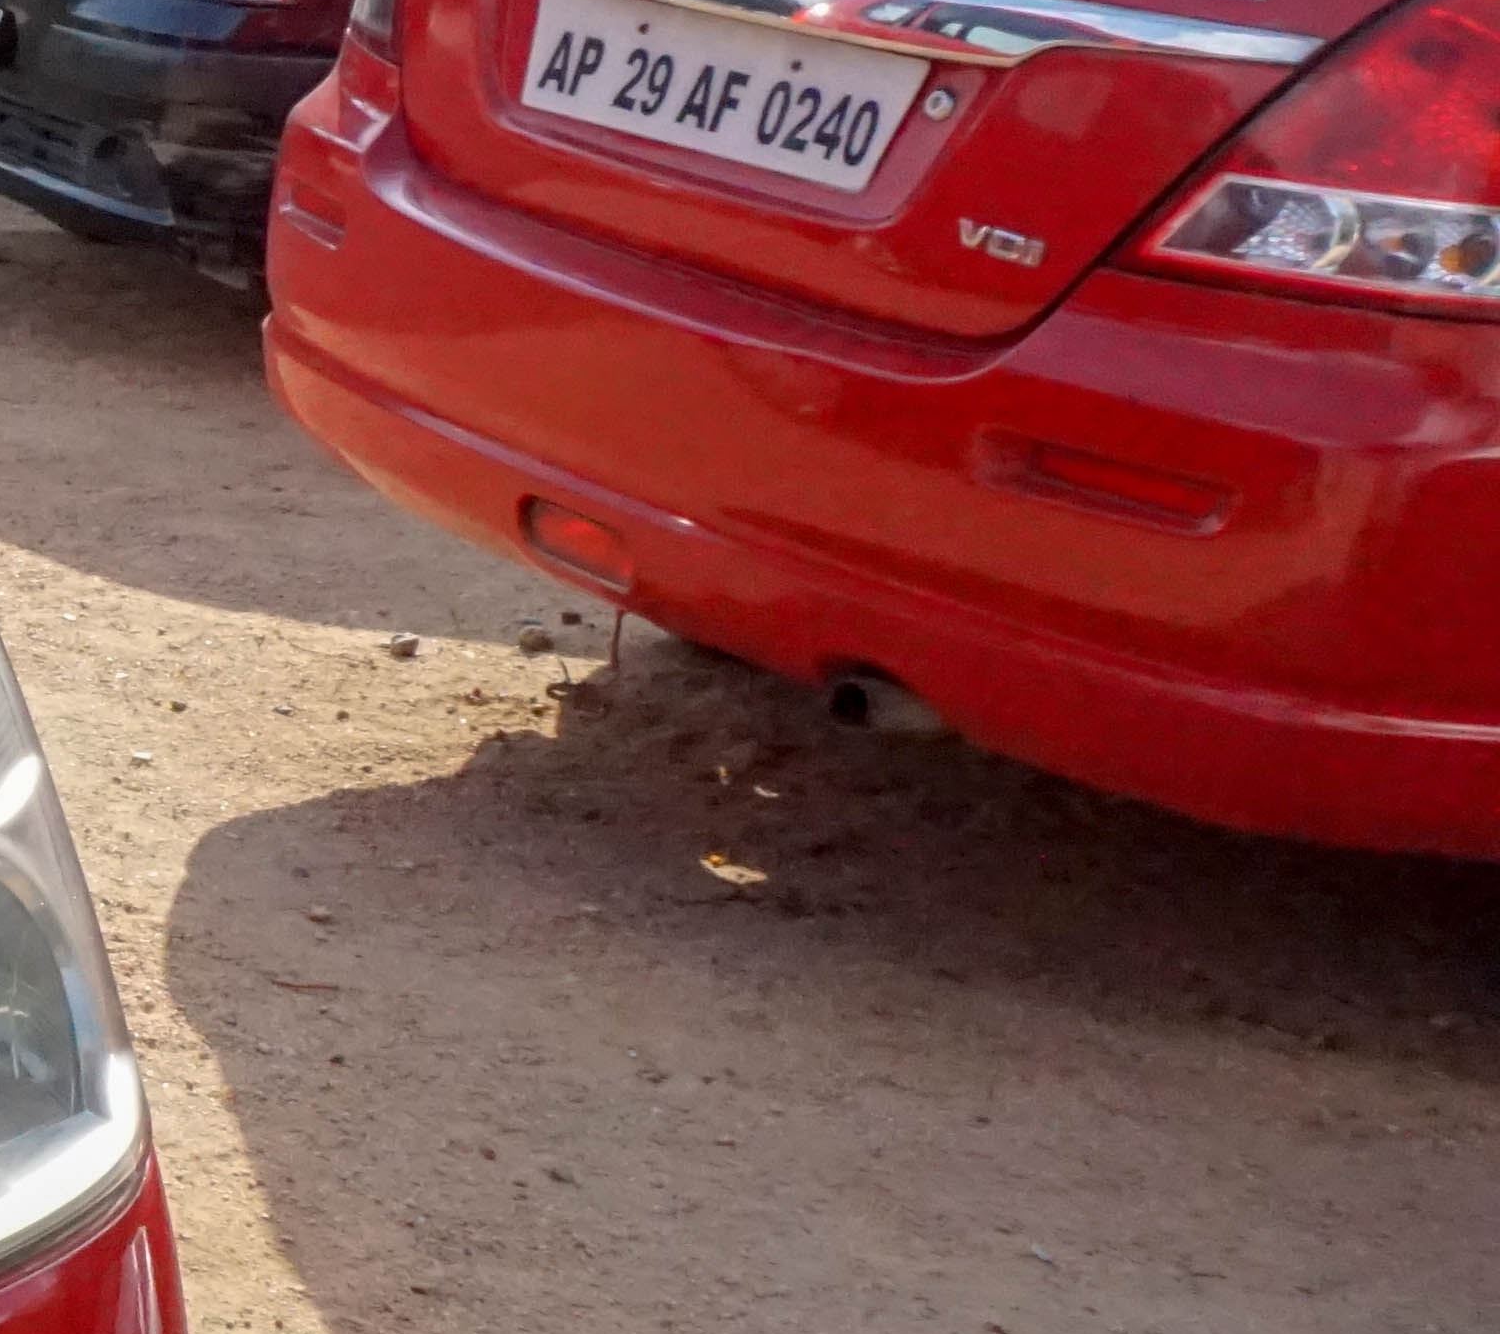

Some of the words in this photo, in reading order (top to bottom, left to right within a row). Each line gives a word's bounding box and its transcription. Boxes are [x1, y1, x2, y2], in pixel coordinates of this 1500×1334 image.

[538, 31, 605, 97] AP
[611, 48, 674, 116] 29
[676, 65, 750, 133] AF
[756, 80, 880, 166] 0240
